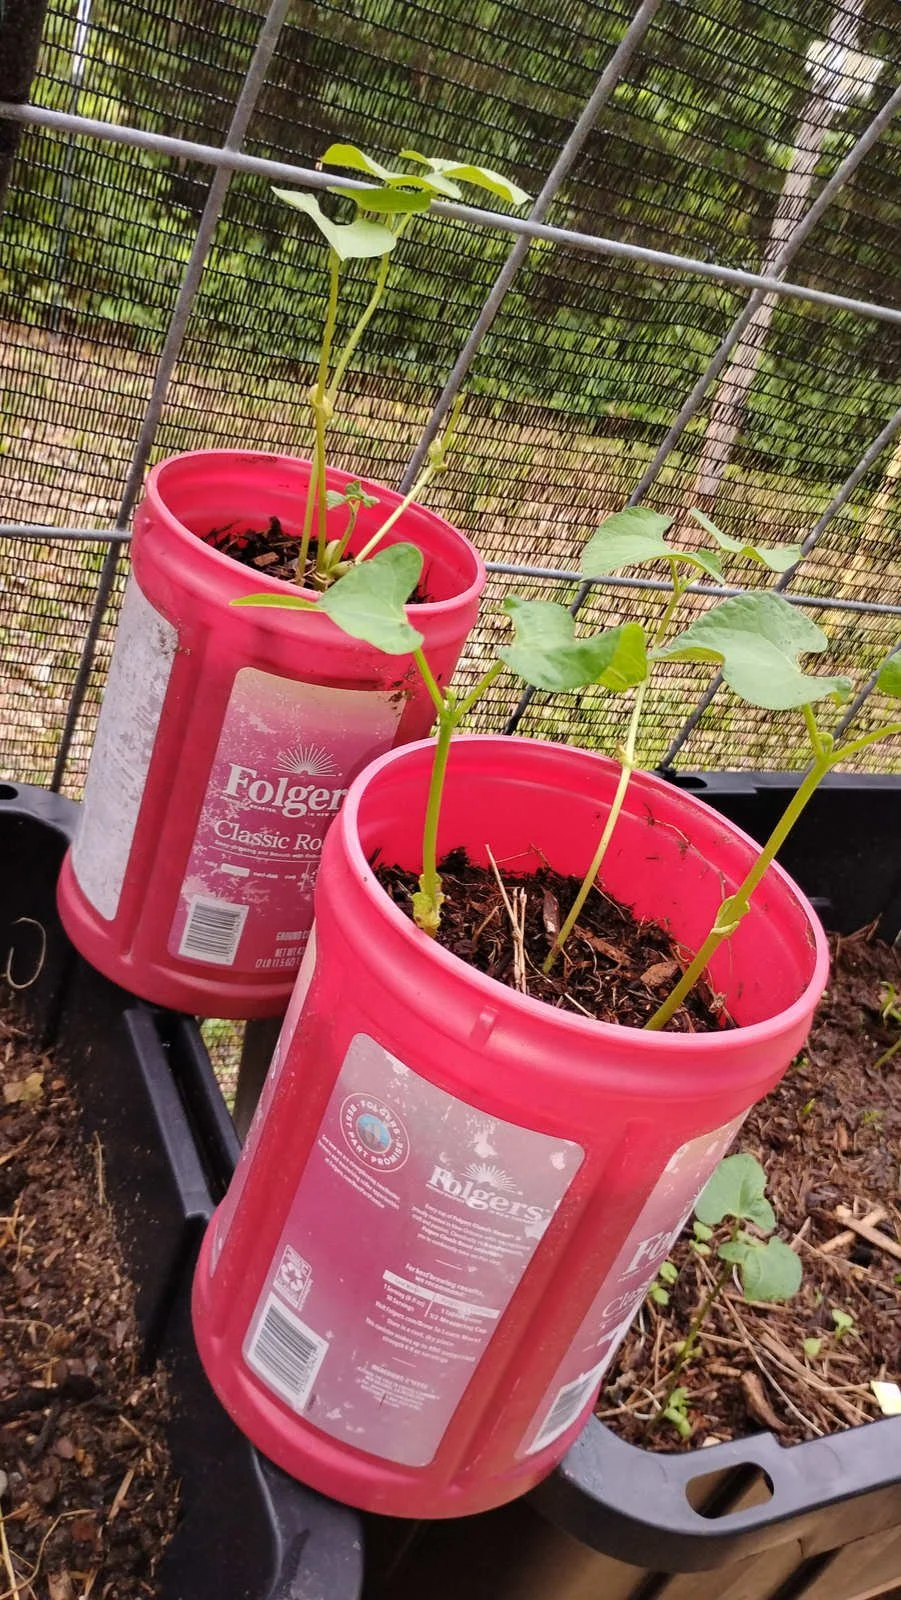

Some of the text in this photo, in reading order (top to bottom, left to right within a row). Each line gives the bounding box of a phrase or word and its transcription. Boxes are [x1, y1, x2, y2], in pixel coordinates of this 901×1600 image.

[221, 763, 349, 818] Folger
[214, 820, 290, 849] Classic
[293, 833, 323, 851] Ro
[428, 1165, 544, 1221] Folgers
